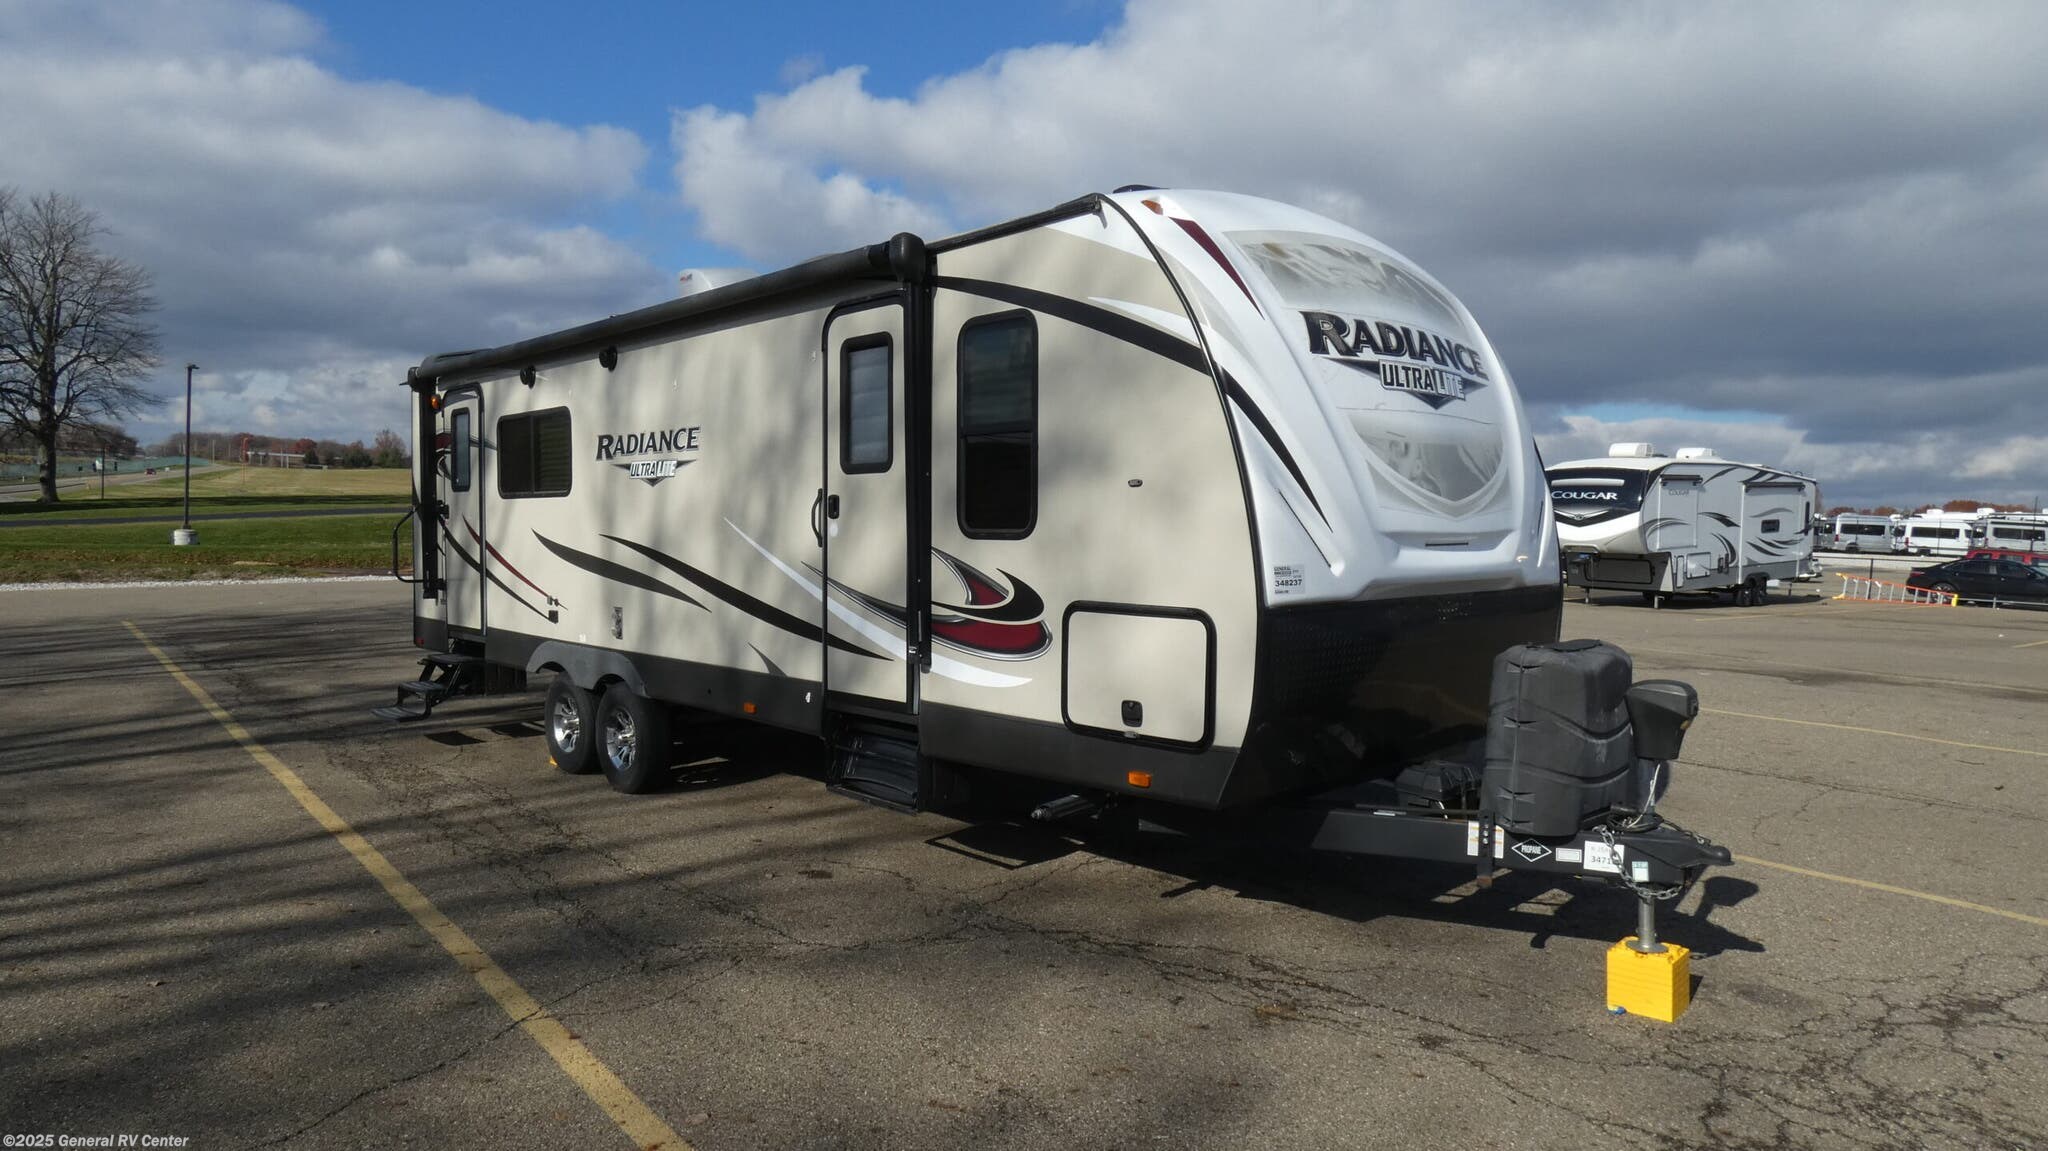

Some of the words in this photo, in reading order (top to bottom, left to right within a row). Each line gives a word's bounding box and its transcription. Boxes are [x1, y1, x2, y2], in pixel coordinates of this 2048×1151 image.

[1299, 311, 1490, 382] RADIANCE
[596, 426, 700, 461] RADIANCE
[1551, 490, 1619, 500] COUGAR
[1274, 579, 1303, 587] 348237
